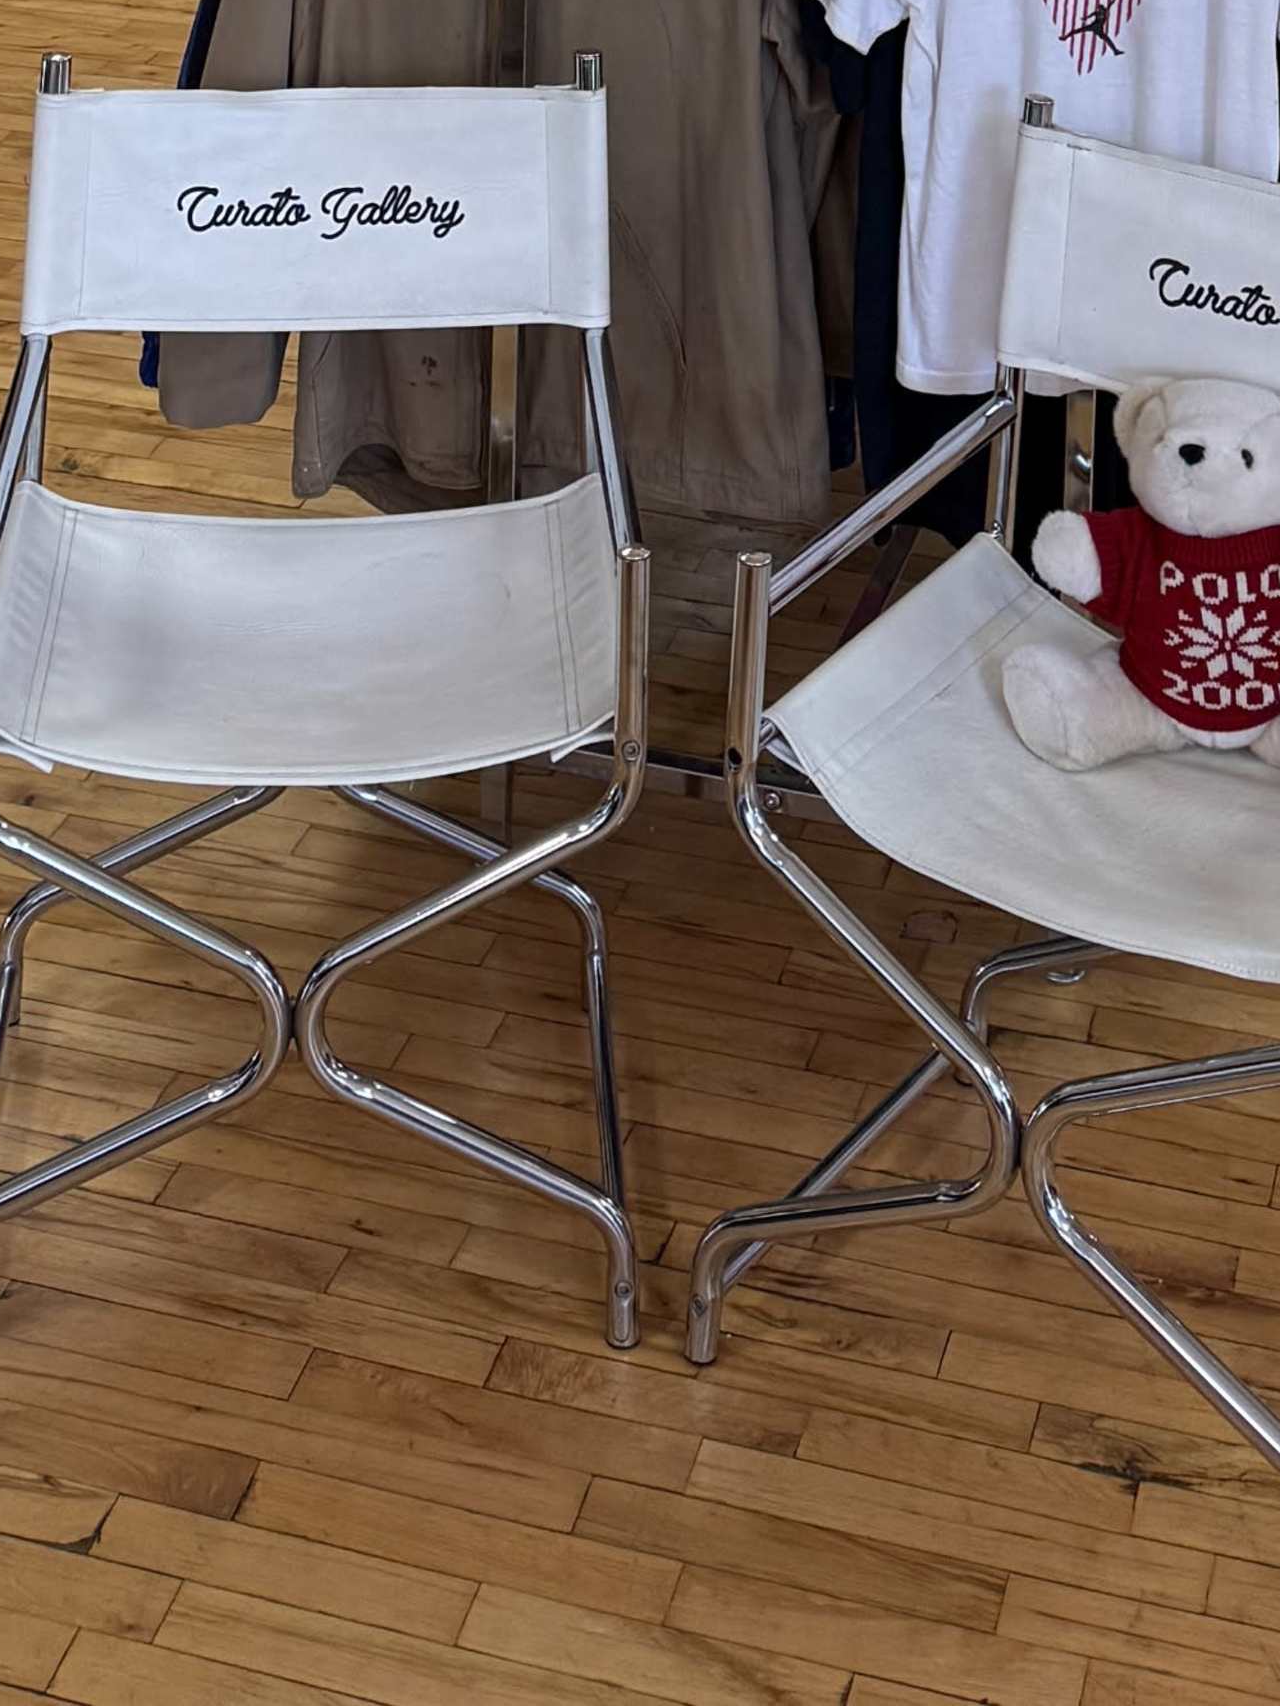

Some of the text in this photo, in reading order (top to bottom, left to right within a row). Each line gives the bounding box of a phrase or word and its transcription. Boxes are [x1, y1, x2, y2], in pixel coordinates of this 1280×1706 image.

[177, 185, 465, 240] Curato Gallery
[1149, 258, 1280, 325] Curato
